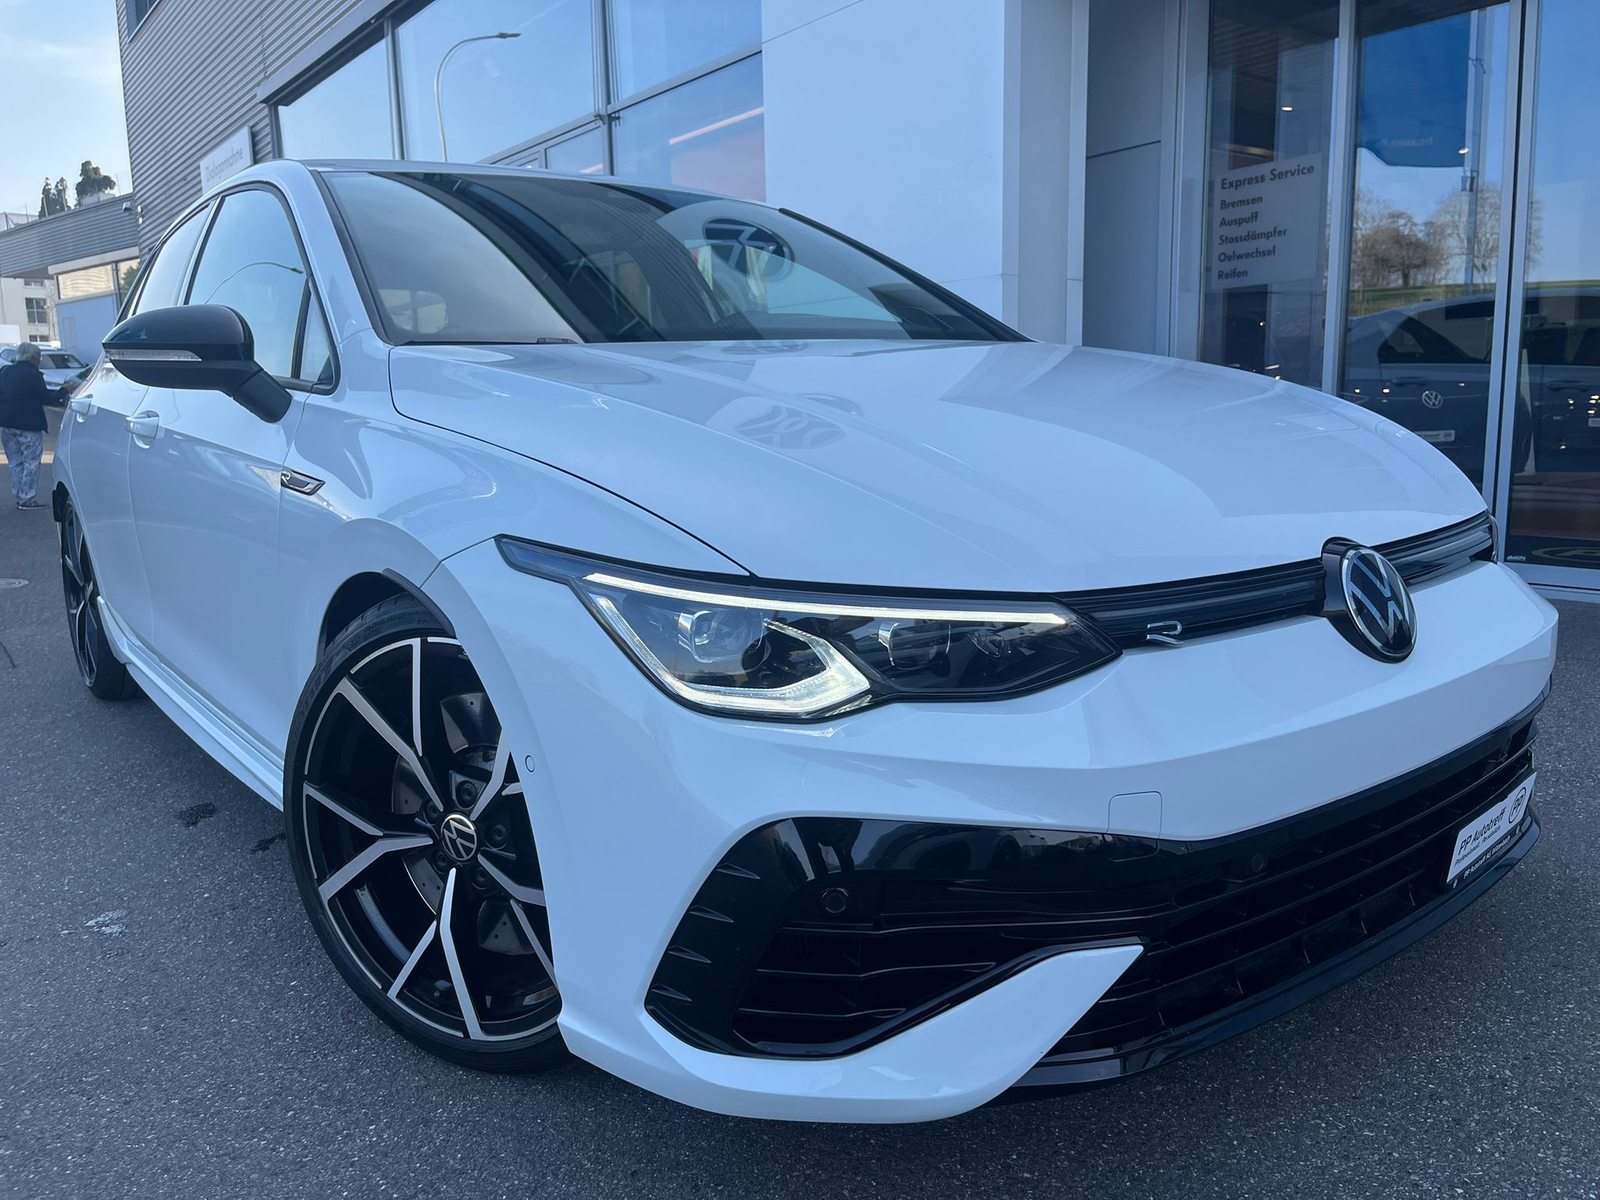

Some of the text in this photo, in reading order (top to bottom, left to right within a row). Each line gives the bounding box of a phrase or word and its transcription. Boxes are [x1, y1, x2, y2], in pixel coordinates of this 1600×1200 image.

[1220, 164, 1315, 190] Express Service
[1220, 195, 1263, 210] Bremsen
[1219, 211, 1259, 227] Auspuff
[1218, 226, 1287, 246] Stossdämpfer
[1218, 245, 1276, 263] Oelwechsel
[1217, 268, 1248, 281] Reifen
[1146, 620, 1184, 646] R
[1471, 806, 1507, 846] Autotreff
